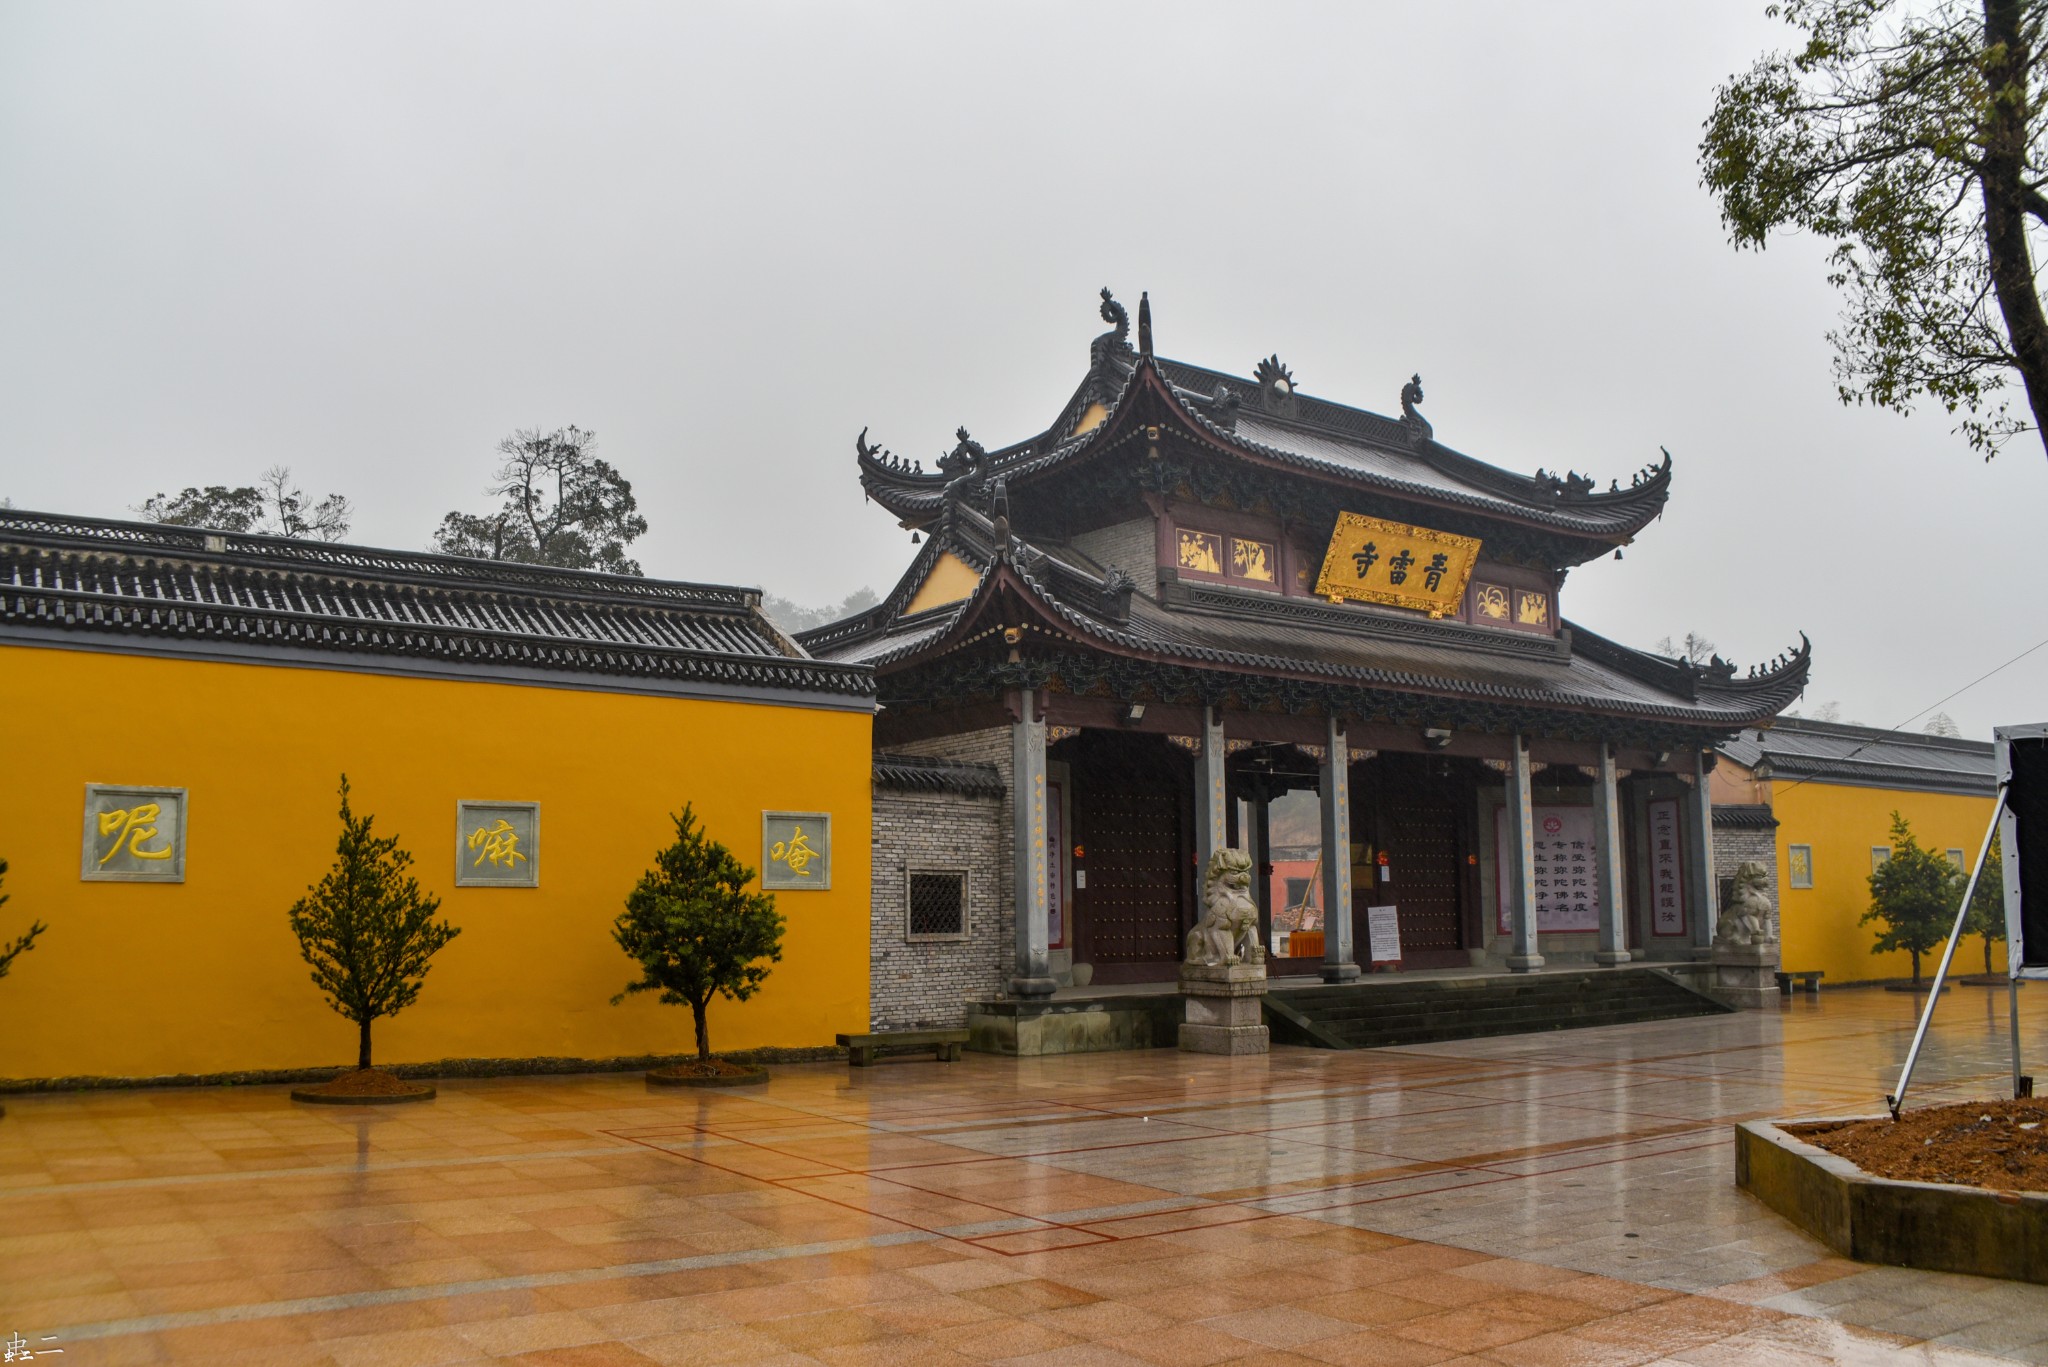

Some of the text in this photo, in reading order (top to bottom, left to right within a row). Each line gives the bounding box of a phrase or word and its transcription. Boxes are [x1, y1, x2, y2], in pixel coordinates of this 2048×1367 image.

[98, 803, 172, 865] 呢
[466, 819, 528, 869] 嘛
[769, 826, 820, 876] 唵
